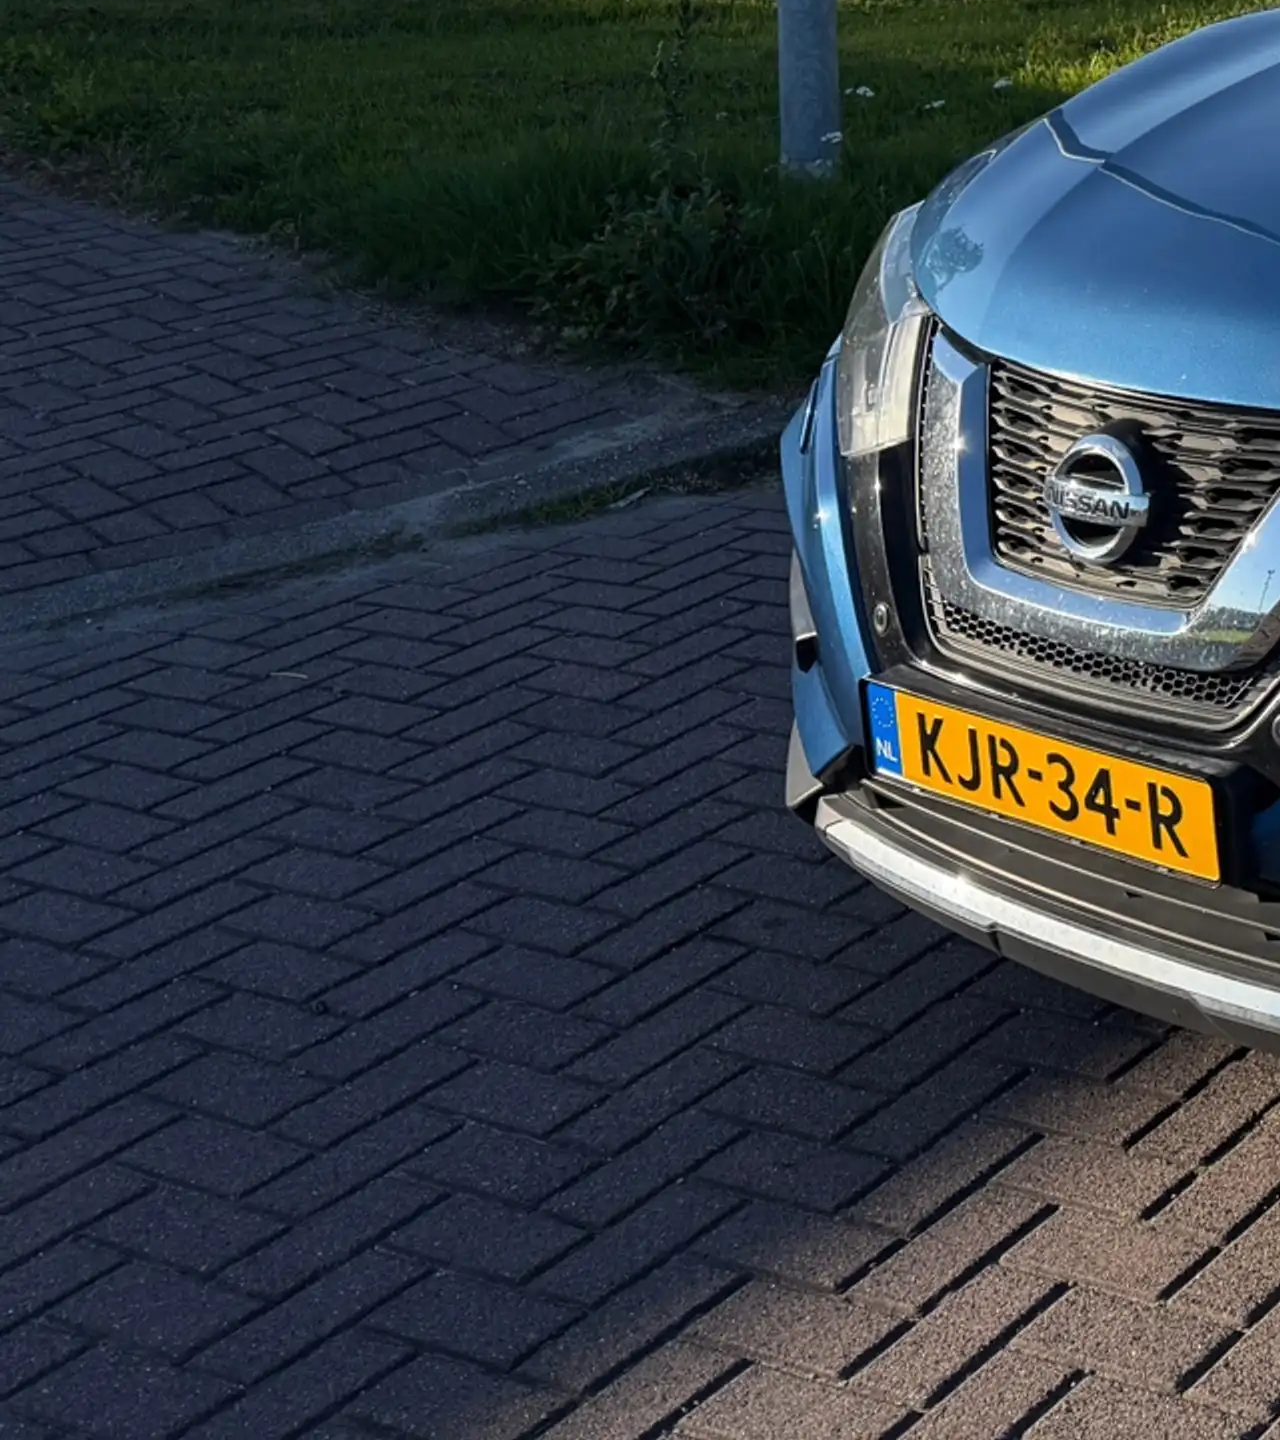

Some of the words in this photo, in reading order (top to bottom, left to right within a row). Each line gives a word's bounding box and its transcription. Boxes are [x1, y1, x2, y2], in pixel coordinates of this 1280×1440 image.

[1049, 486, 1131, 520] NISSAN
[875, 735, 899, 763] NL
[916, 711, 1190, 860] KJR-34-R
